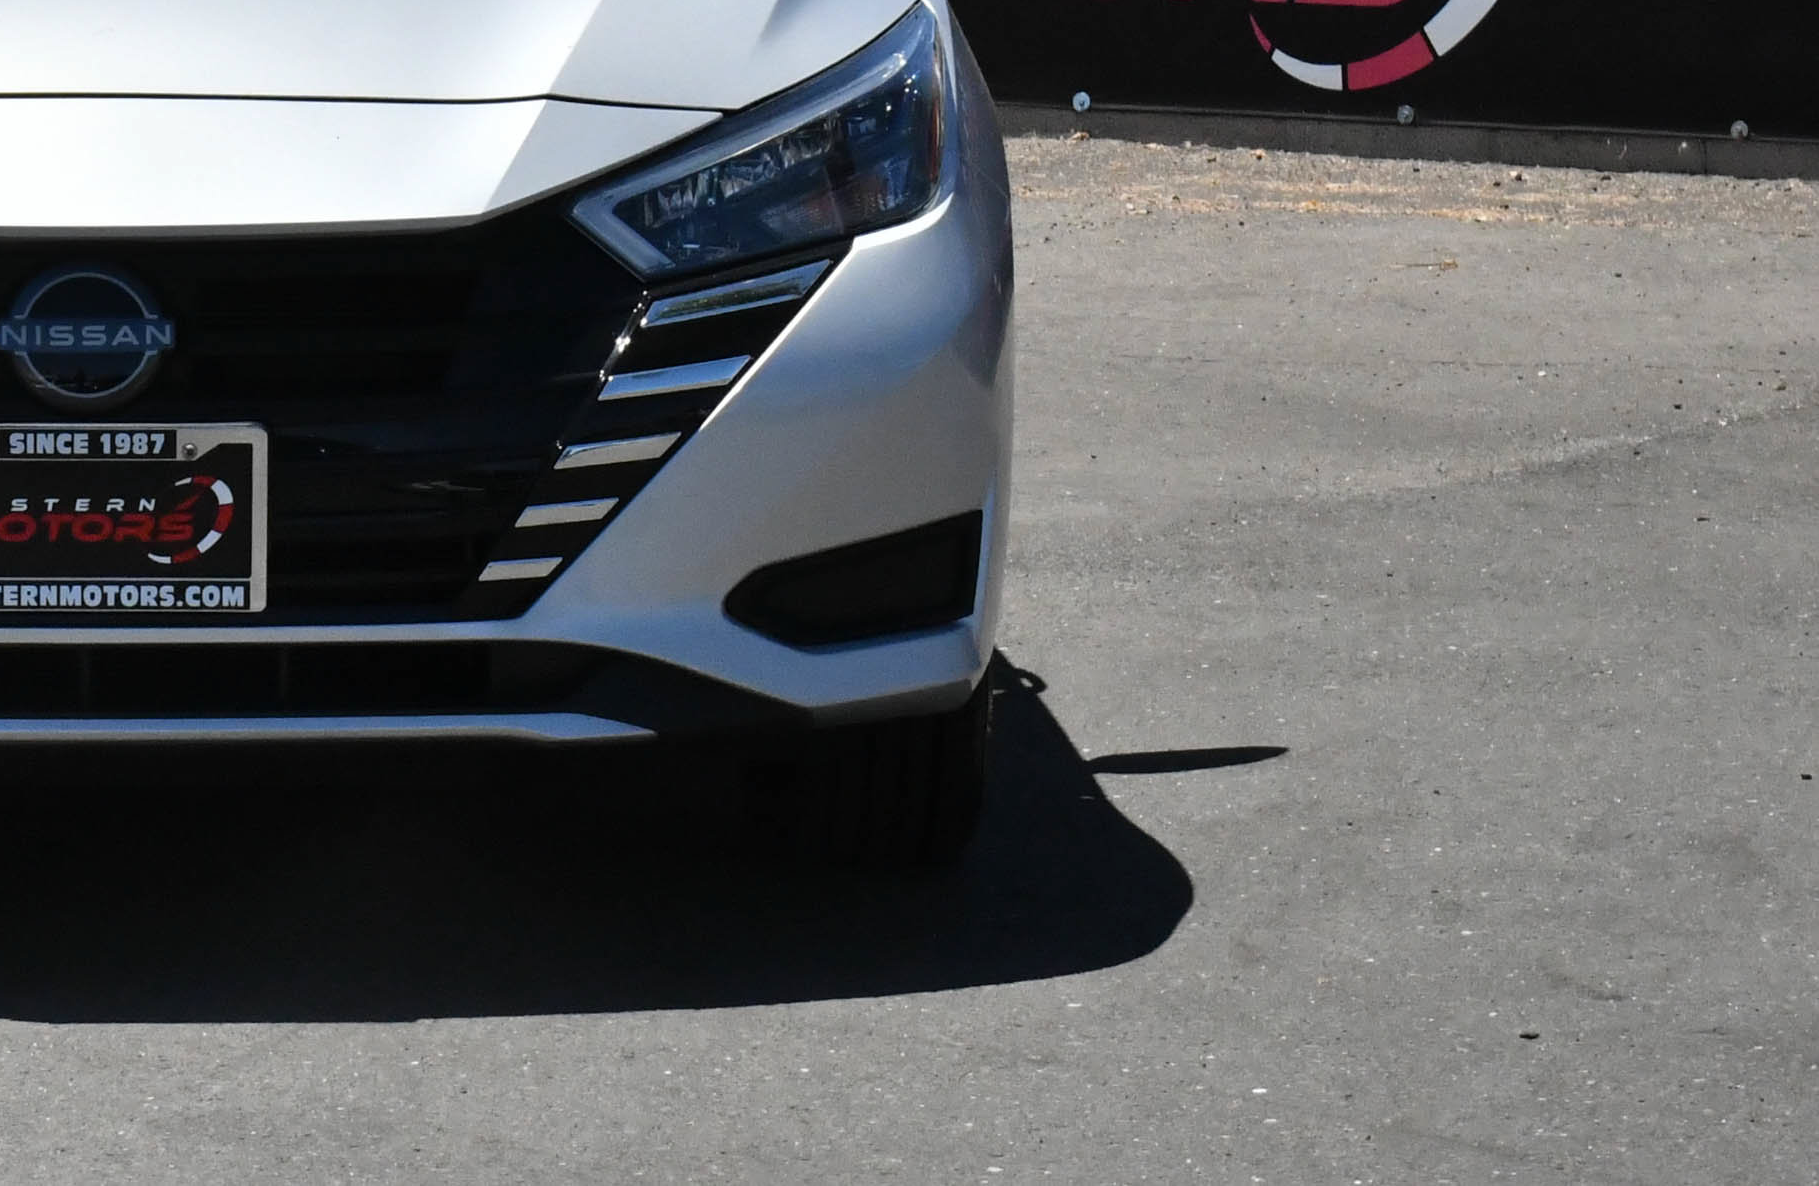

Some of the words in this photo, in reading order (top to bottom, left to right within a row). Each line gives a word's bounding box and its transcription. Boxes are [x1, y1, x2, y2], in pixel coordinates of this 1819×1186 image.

[0, 324, 172, 347] NISSAN
[8, 433, 89, 455] SINCE
[100, 432, 165, 455] 1987
